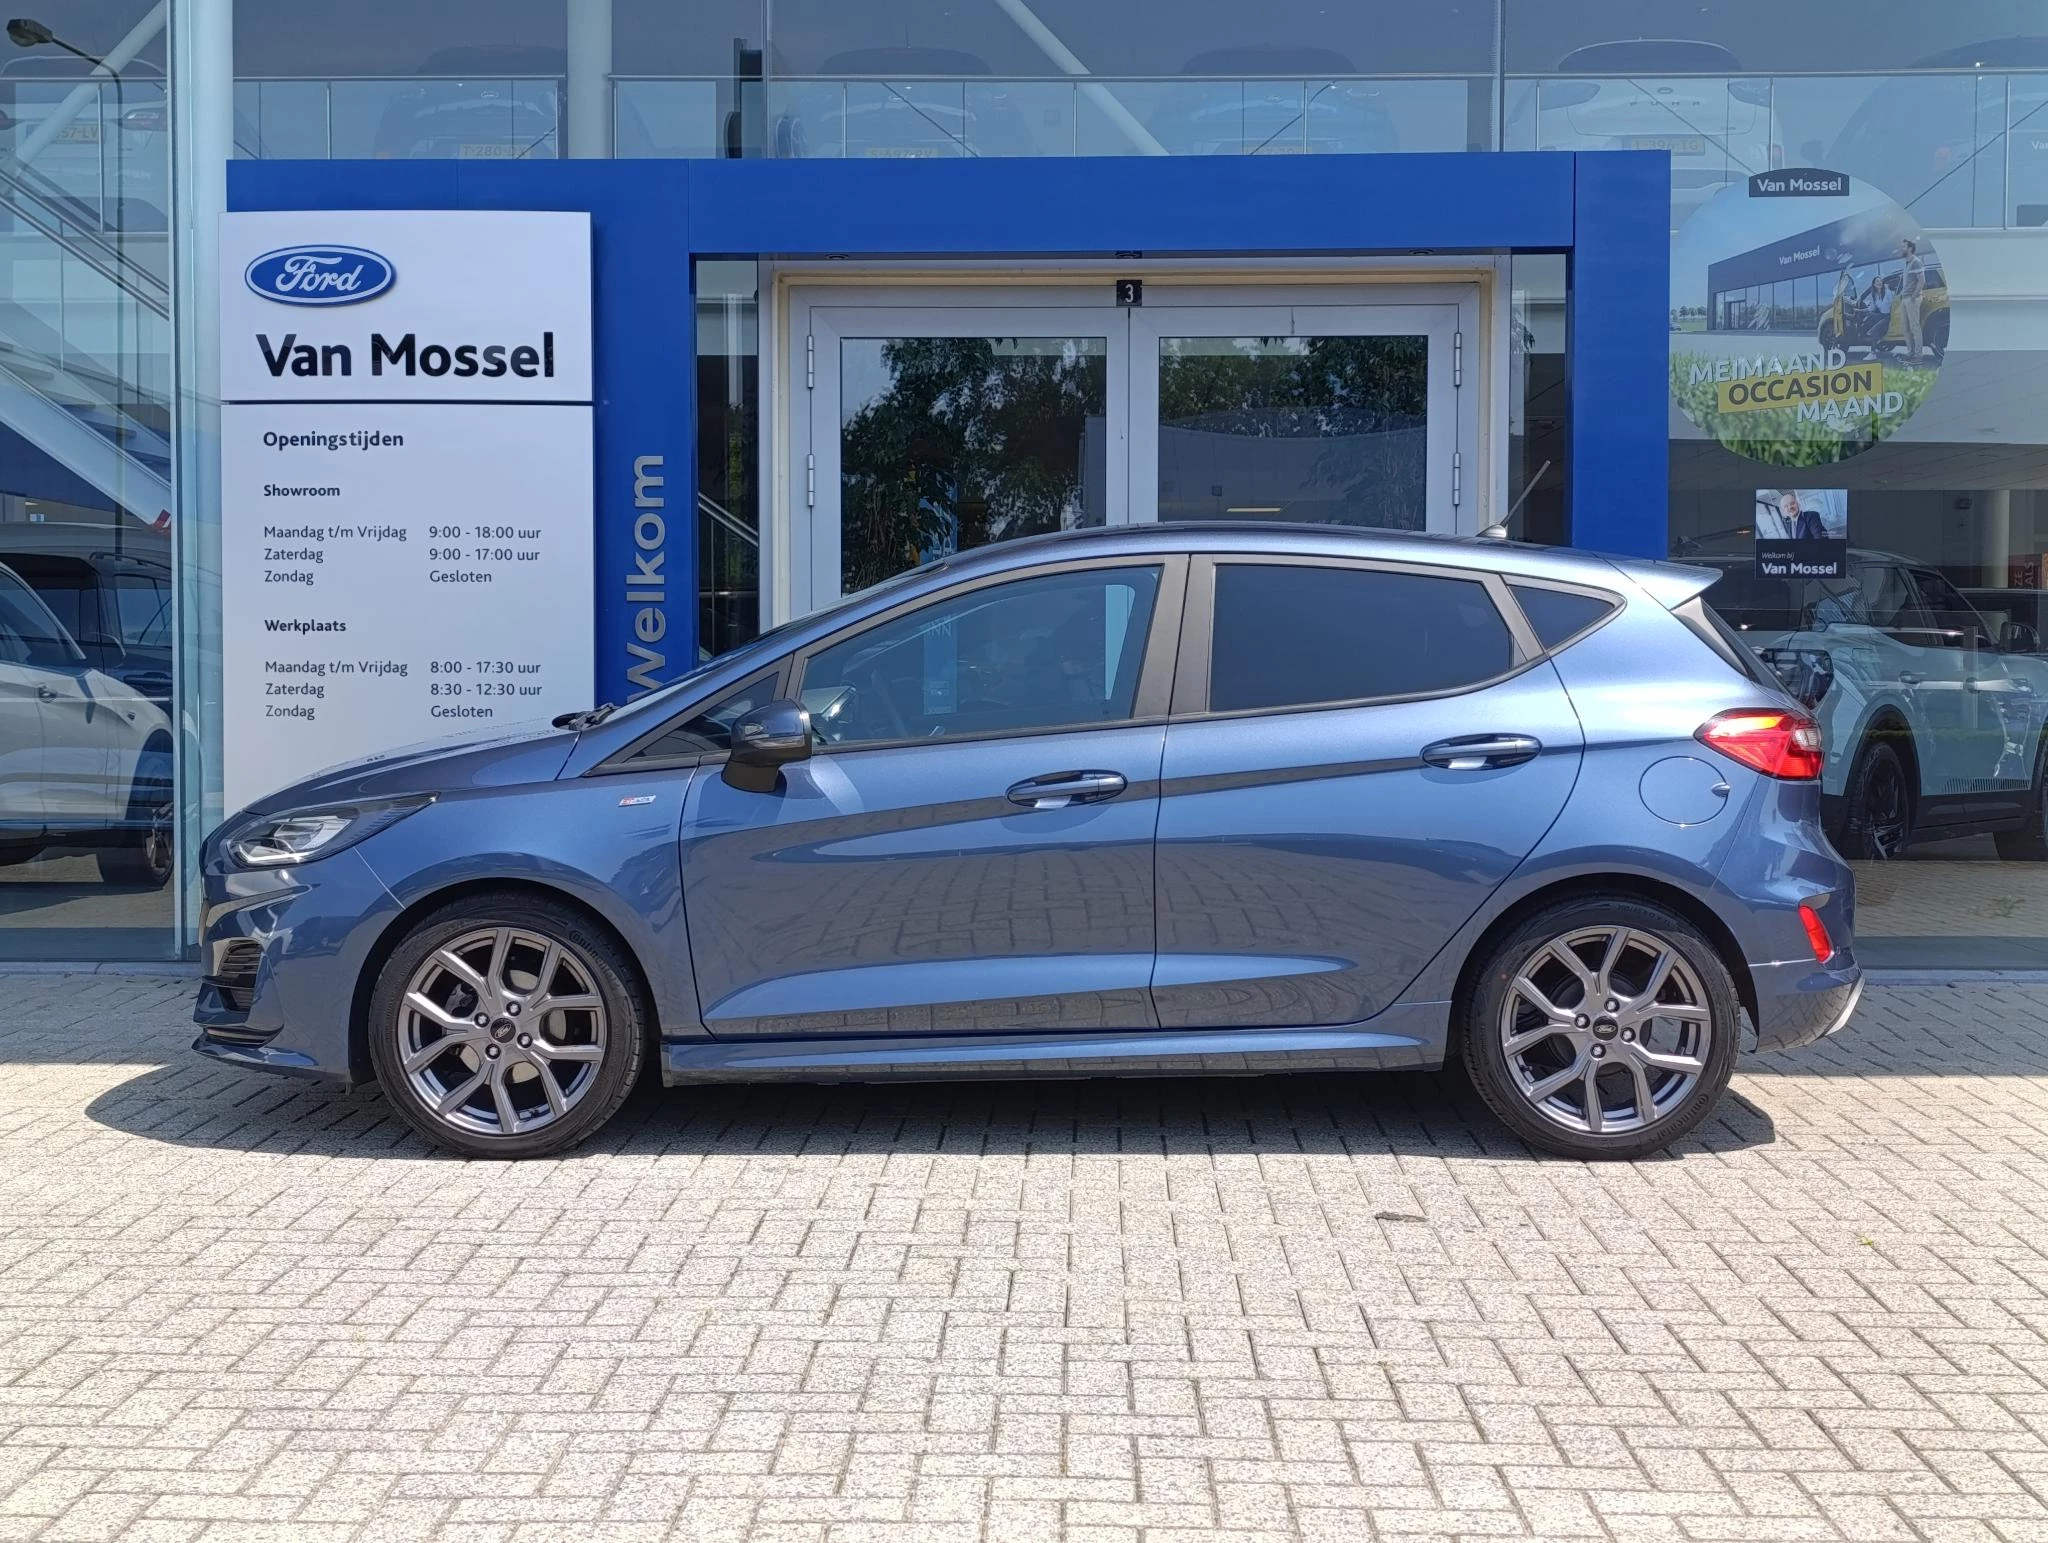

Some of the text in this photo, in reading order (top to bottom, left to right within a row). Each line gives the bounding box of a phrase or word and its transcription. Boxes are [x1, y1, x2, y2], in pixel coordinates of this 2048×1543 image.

[1757, 177, 1842, 192] Van Mossel
[1779, 246, 1821, 265] Van Mossel
[275, 255, 364, 292] Ford
[1125, 284, 1134, 303] 3
[256, 332, 555, 378] Van Mossel
[1690, 349, 1847, 385] MEIMAAND
[1728, 370, 1872, 405] OCCASION
[1797, 392, 1904, 423] MAAND
[263, 430, 405, 453] Openingstijden
[263, 483, 341, 497] Showroom
[264, 525, 408, 542] Maandag t/m Vrijdag
[429, 526, 461, 539] 9:00
[474, 526, 515, 539] 18:00
[518, 529, 542, 539] uur
[264, 547, 324, 563] Zaterdag
[429, 548, 461, 561] 9:00
[475, 548, 513, 561] 17:00
[517, 551, 541, 561] uur
[429, 570, 492, 583] Gesloten
[1762, 562, 1837, 574] Van Mossel
[264, 570, 314, 586] Zondag
[626, 455, 666, 700] Welkom
[264, 619, 347, 636] Werkplaats
[265, 660, 409, 677] Maandag t/m Vrijdag
[430, 661, 463, 674] 8:00
[476, 661, 514, 674] 17:30
[518, 664, 542, 674] uur
[265, 682, 325, 698] Zaterdag
[430, 683, 463, 696] 8:30
[476, 683, 516, 696] 12:30
[519, 686, 543, 696] uur
[265, 704, 316, 721] Zondag
[430, 705, 494, 718] Gesloten
